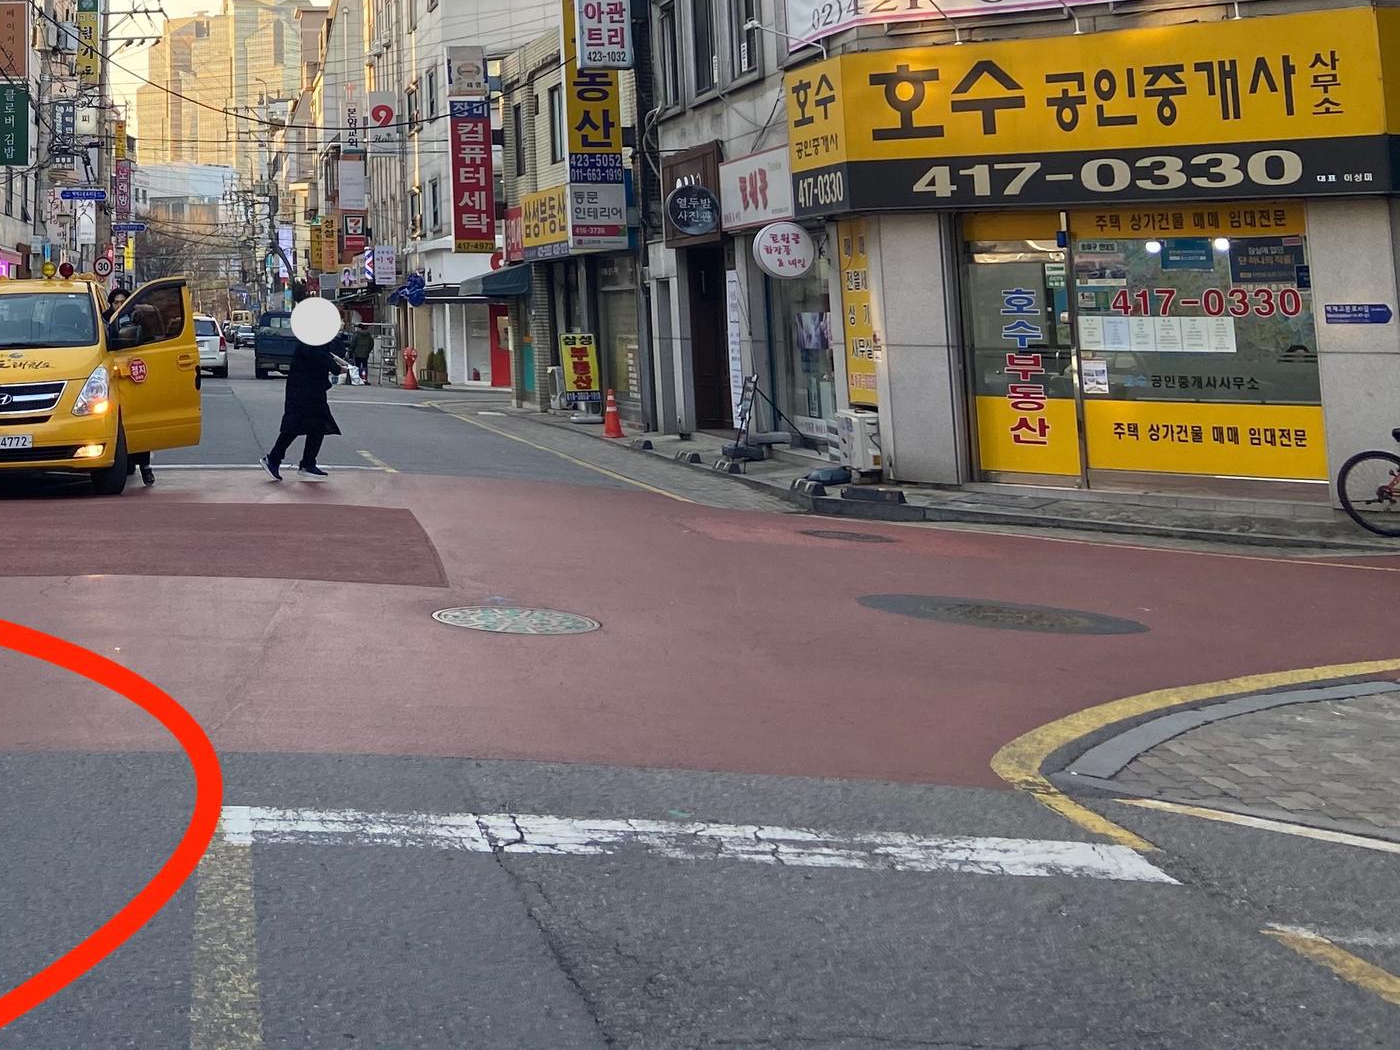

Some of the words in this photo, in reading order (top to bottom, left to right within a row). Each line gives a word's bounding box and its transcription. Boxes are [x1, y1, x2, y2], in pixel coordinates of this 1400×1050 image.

[587, 51, 627, 63] 423-1032
[791, 71, 837, 129] 호수
[868, 59, 1026, 143] 호수
[1045, 53, 1297, 133] 공인중개사
[1308, 49, 1345, 116] 사무소
[4, 132, 16, 159] 김밥
[795, 131, 839, 160] 공인중개사
[570, 154, 622, 167] 423-5052
[457, 121, 491, 234] 컴퓨터세탁
[571, 168, 623, 182] 011-663-1919
[910, 149, 1303, 200] 417-0330
[797, 169, 844, 208] 417-0330
[574, 206, 623, 220] 인테리어
[1095, 213, 1122, 231] 주택
[1128, 211, 1185, 231] 상가건물
[1193, 211, 1220, 230] 매매
[1228, 208, 1287, 229] 임대전문
[97, 262, 109, 270] 30
[1111, 287, 1303, 319] 417-0330
[1000, 287, 1044, 349] 호수
[131, 365, 146, 376] 정지
[570, 346, 593, 390] 부동산
[1151, 374, 1260, 391] 공인중개사사무소
[1003, 352, 1051, 447] 부동산
[0, 436, 28, 447] 4772
[1112, 422, 1140, 442] 주택
[1148, 422, 1204, 444] 상가건물
[1212, 424, 1240, 446] 매매
[1249, 425, 1308, 448] 임대전문
